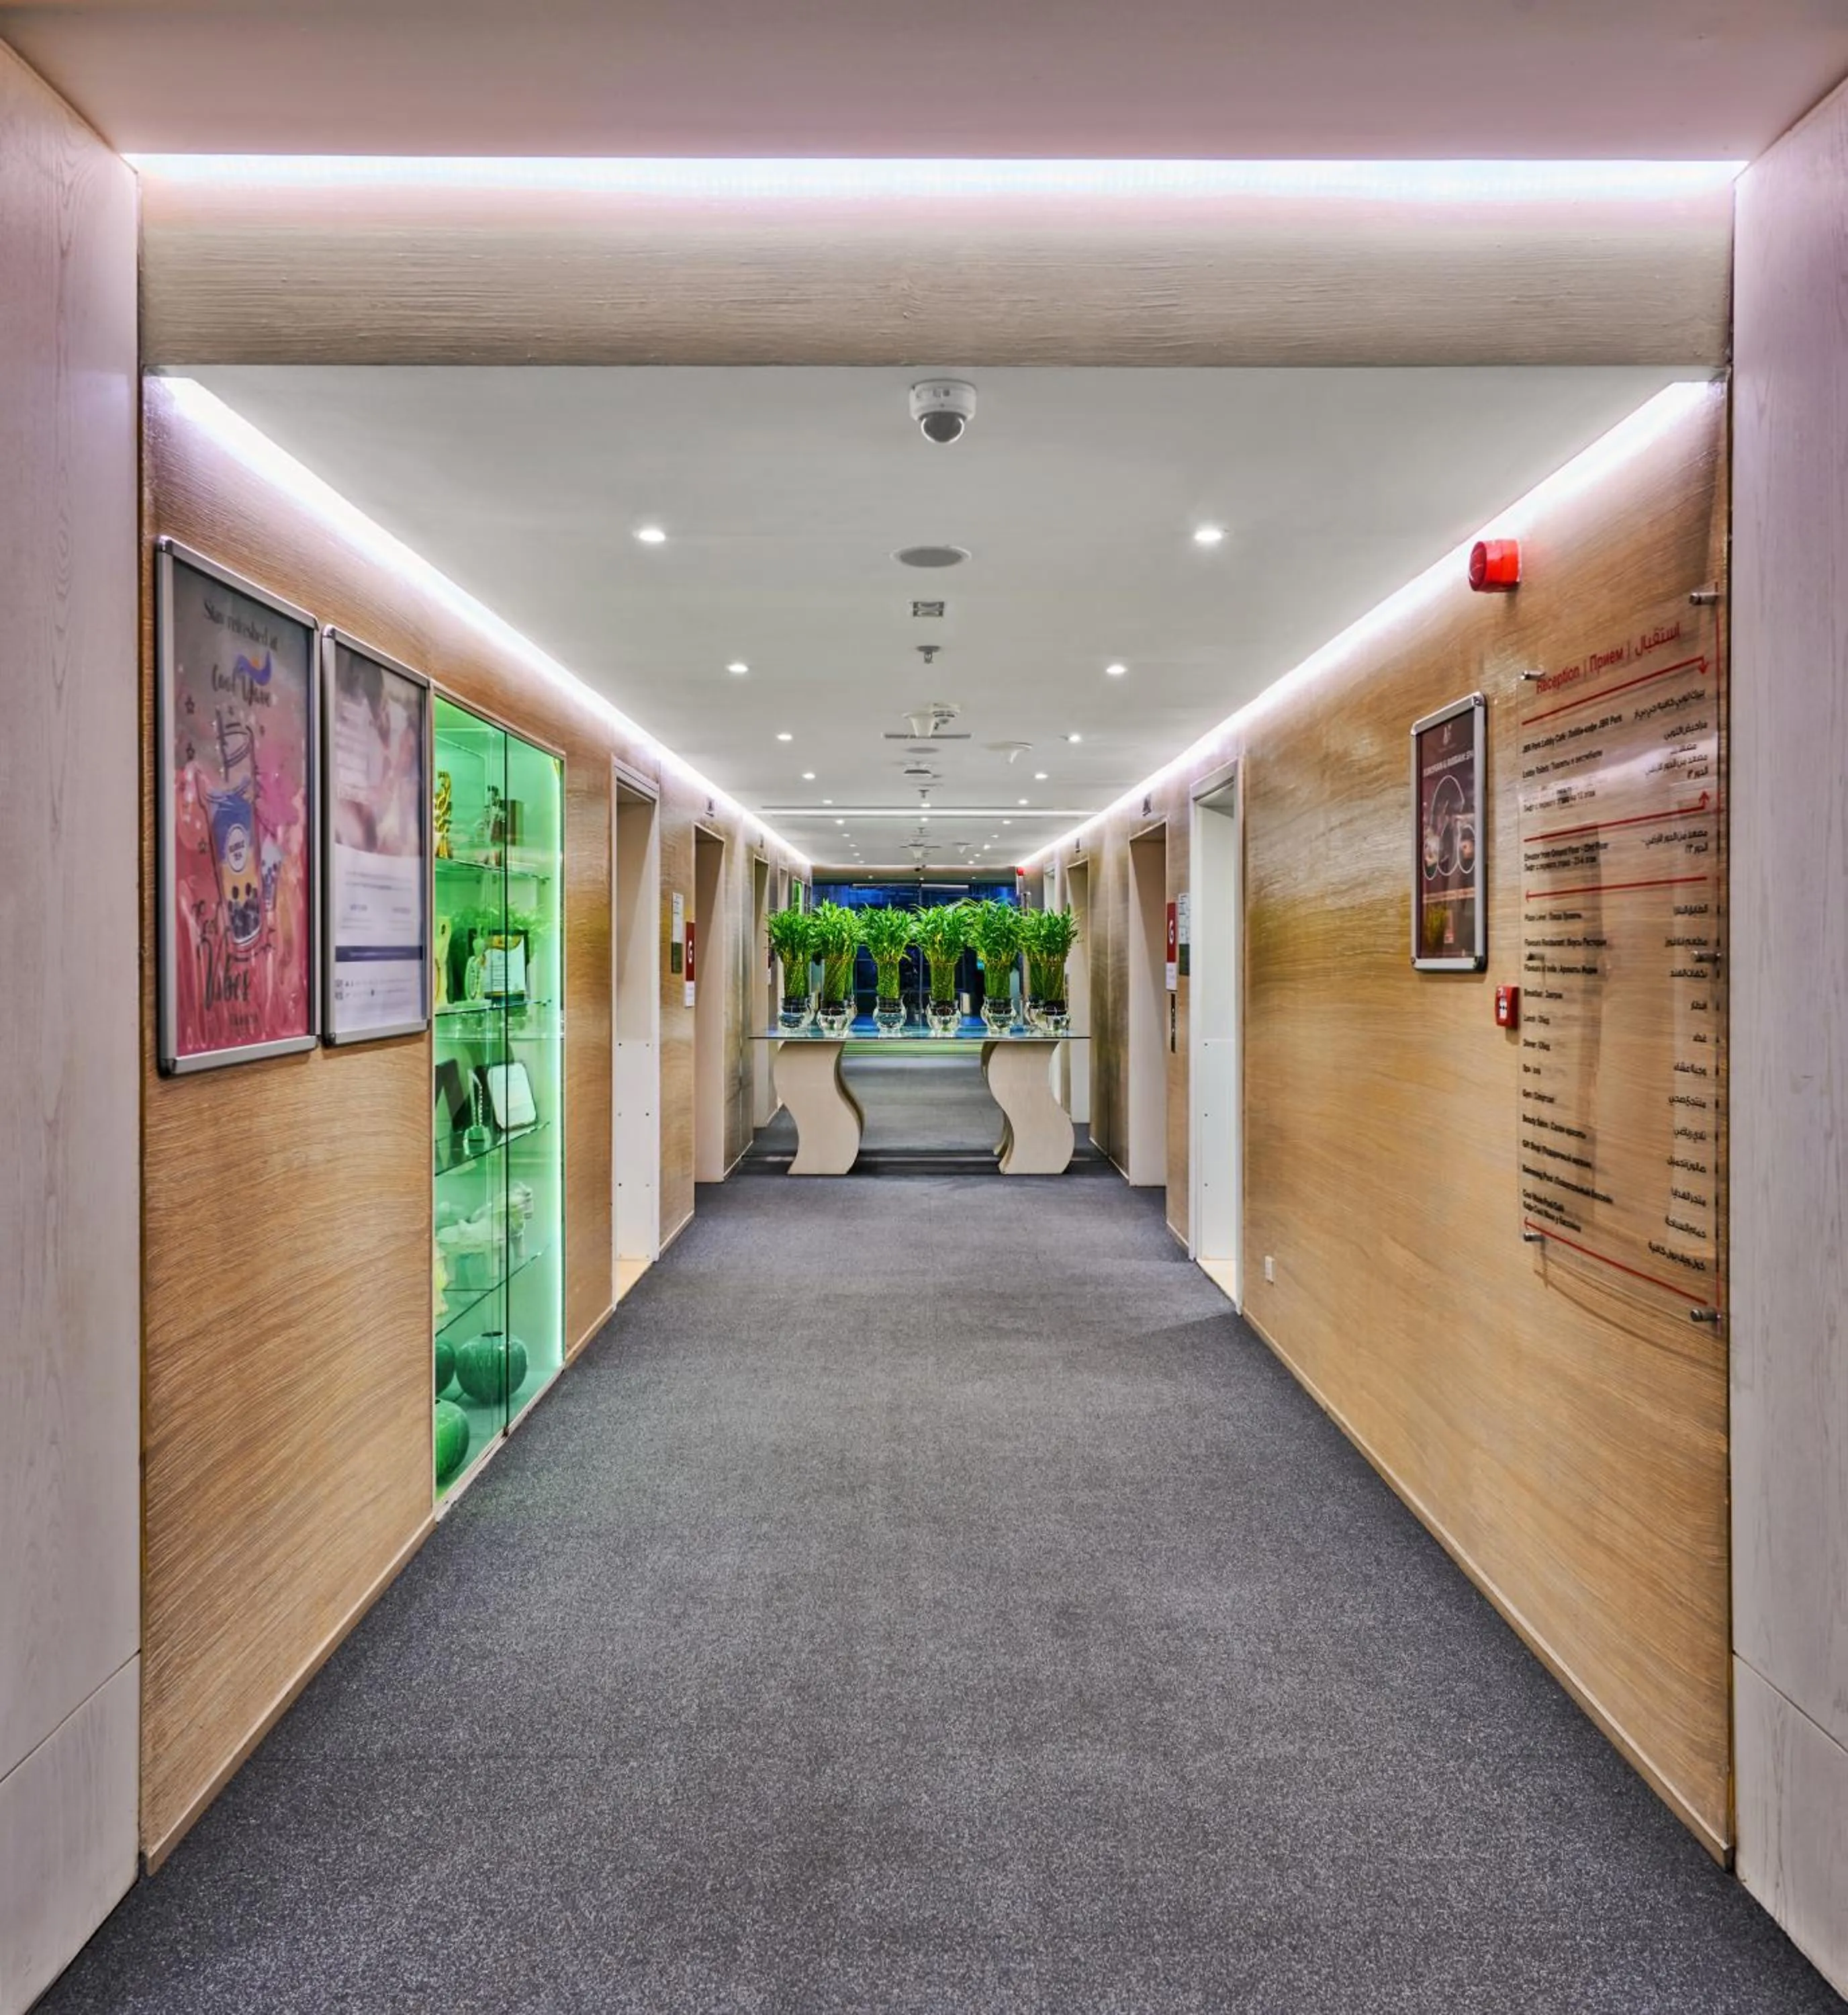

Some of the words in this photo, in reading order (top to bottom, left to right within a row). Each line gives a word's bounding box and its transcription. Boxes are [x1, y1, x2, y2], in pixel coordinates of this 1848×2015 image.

[1634, 622, 1681, 656] استقبال
[1589, 647, 1624, 674] Прием
[1536, 666, 1579, 695] Reception
